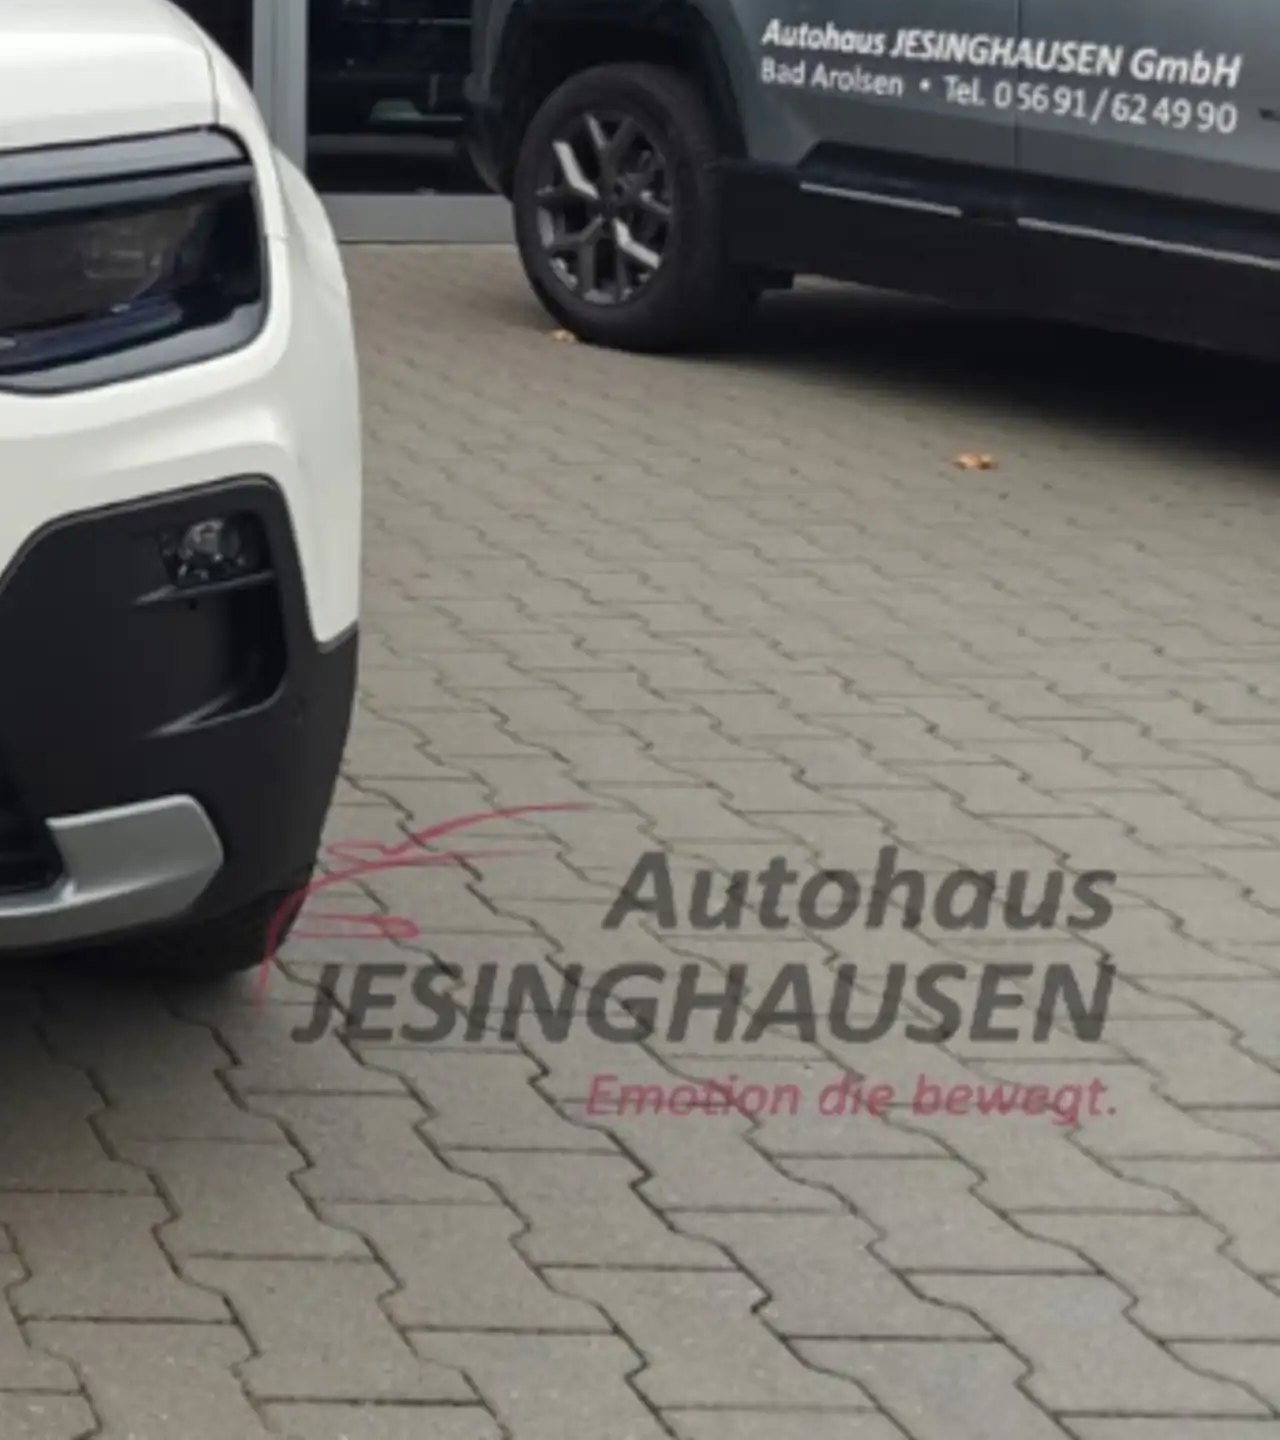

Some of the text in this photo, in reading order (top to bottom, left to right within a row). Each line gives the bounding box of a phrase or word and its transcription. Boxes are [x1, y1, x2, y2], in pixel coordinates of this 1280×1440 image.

[761, 18, 1243, 89] Autohaus JESINGHAUSEN GmbH
[761, 57, 806, 85] Bad
[811, 63, 904, 98] Arolsen
[943, 74, 986, 107] Tel.
